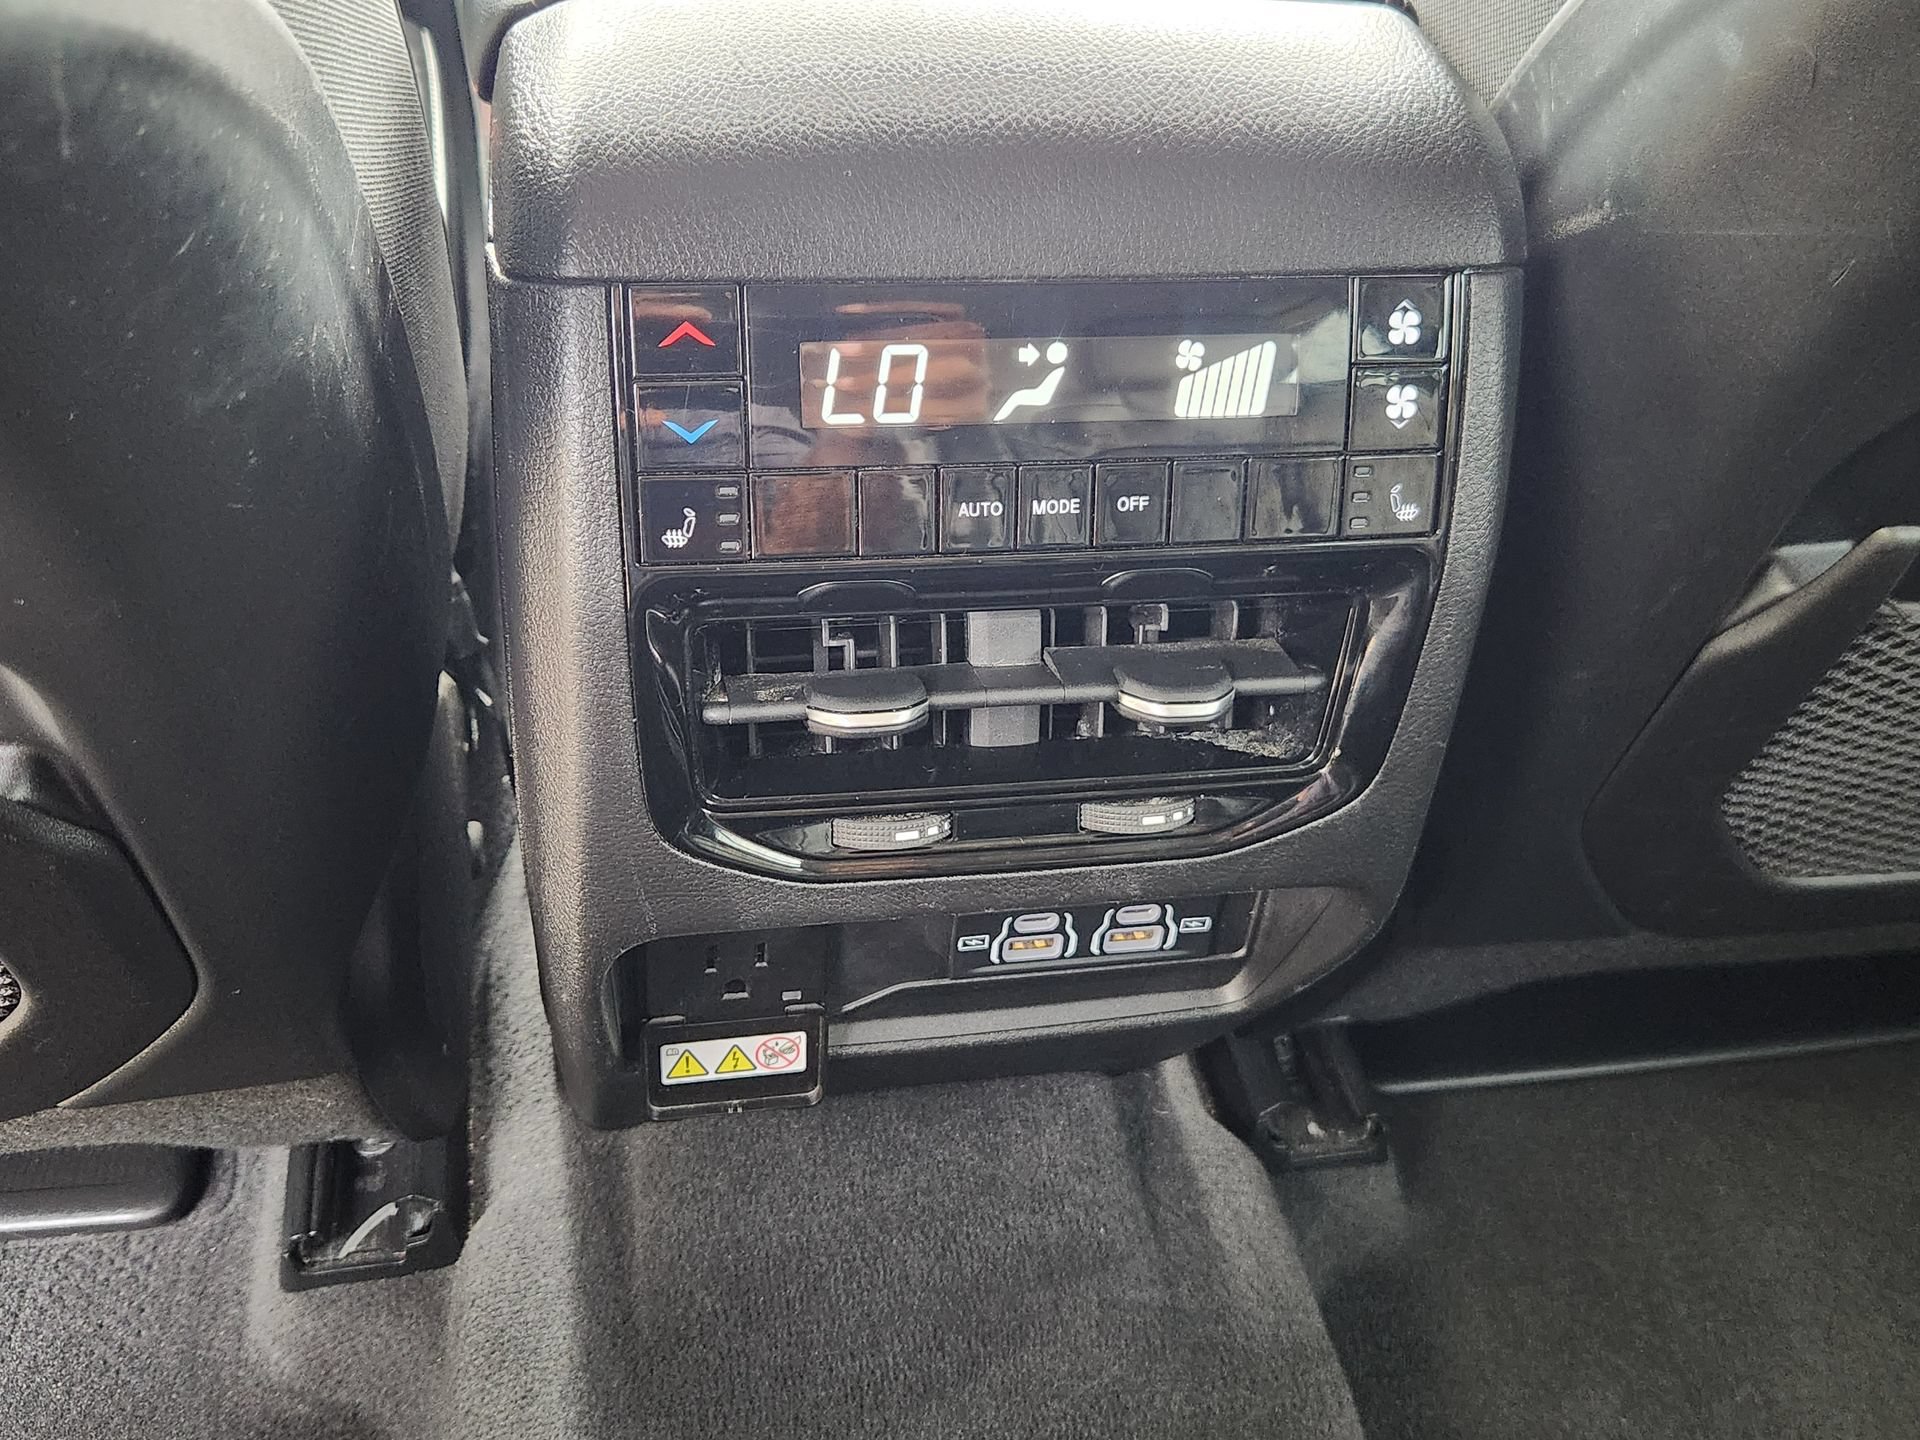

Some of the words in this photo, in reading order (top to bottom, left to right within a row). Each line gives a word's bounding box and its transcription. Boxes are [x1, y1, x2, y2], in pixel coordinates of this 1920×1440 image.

[822, 344, 928, 424] LO
[958, 501, 1003, 517] AUTO
[1032, 498, 1080, 515] MODE
[1116, 495, 1150, 512] OFF
